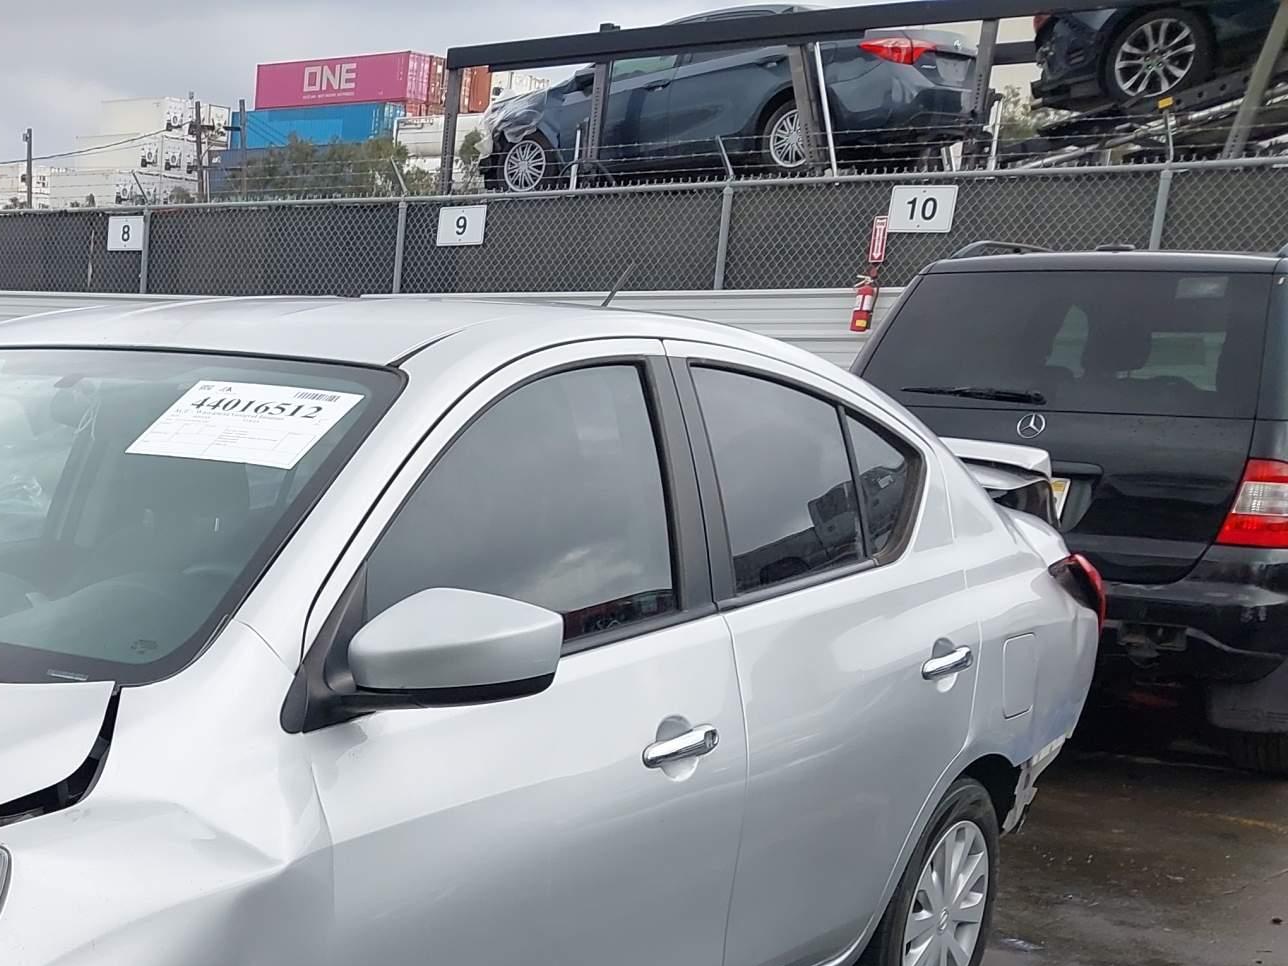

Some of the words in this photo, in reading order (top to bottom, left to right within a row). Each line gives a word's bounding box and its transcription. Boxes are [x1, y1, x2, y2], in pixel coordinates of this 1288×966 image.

[303, 62, 357, 92] ONE
[906, 197, 938, 221] 10
[121, 224, 131, 242] 8
[455, 216, 468, 236] 9
[191, 396, 323, 419] 44016512
